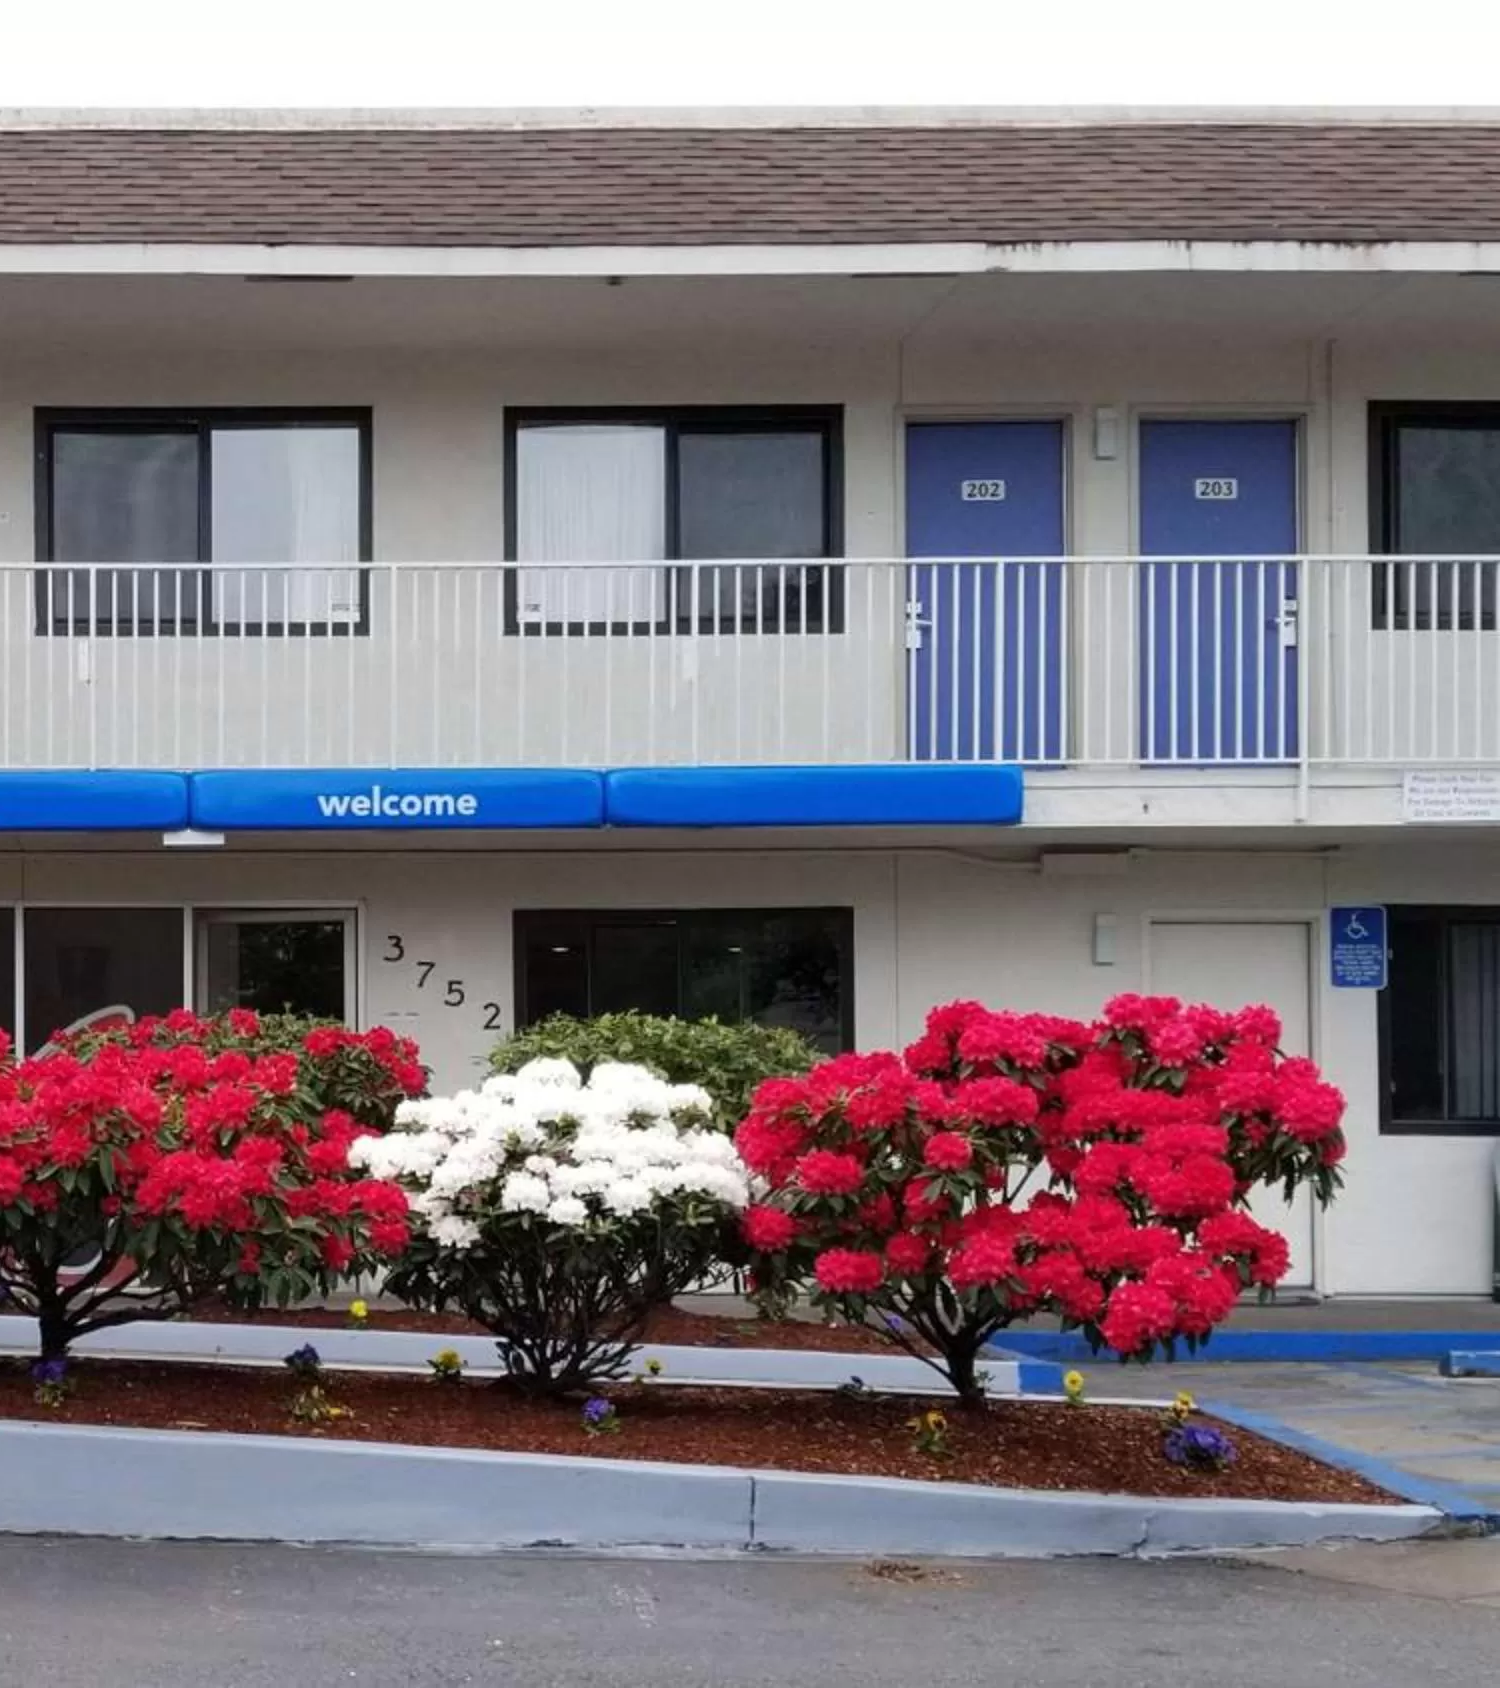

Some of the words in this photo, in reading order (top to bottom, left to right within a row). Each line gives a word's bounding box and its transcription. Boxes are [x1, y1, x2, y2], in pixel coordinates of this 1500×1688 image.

[967, 483, 1000, 498] 202
[1200, 481, 1233, 497] 203
[317, 785, 478, 817] welcome
